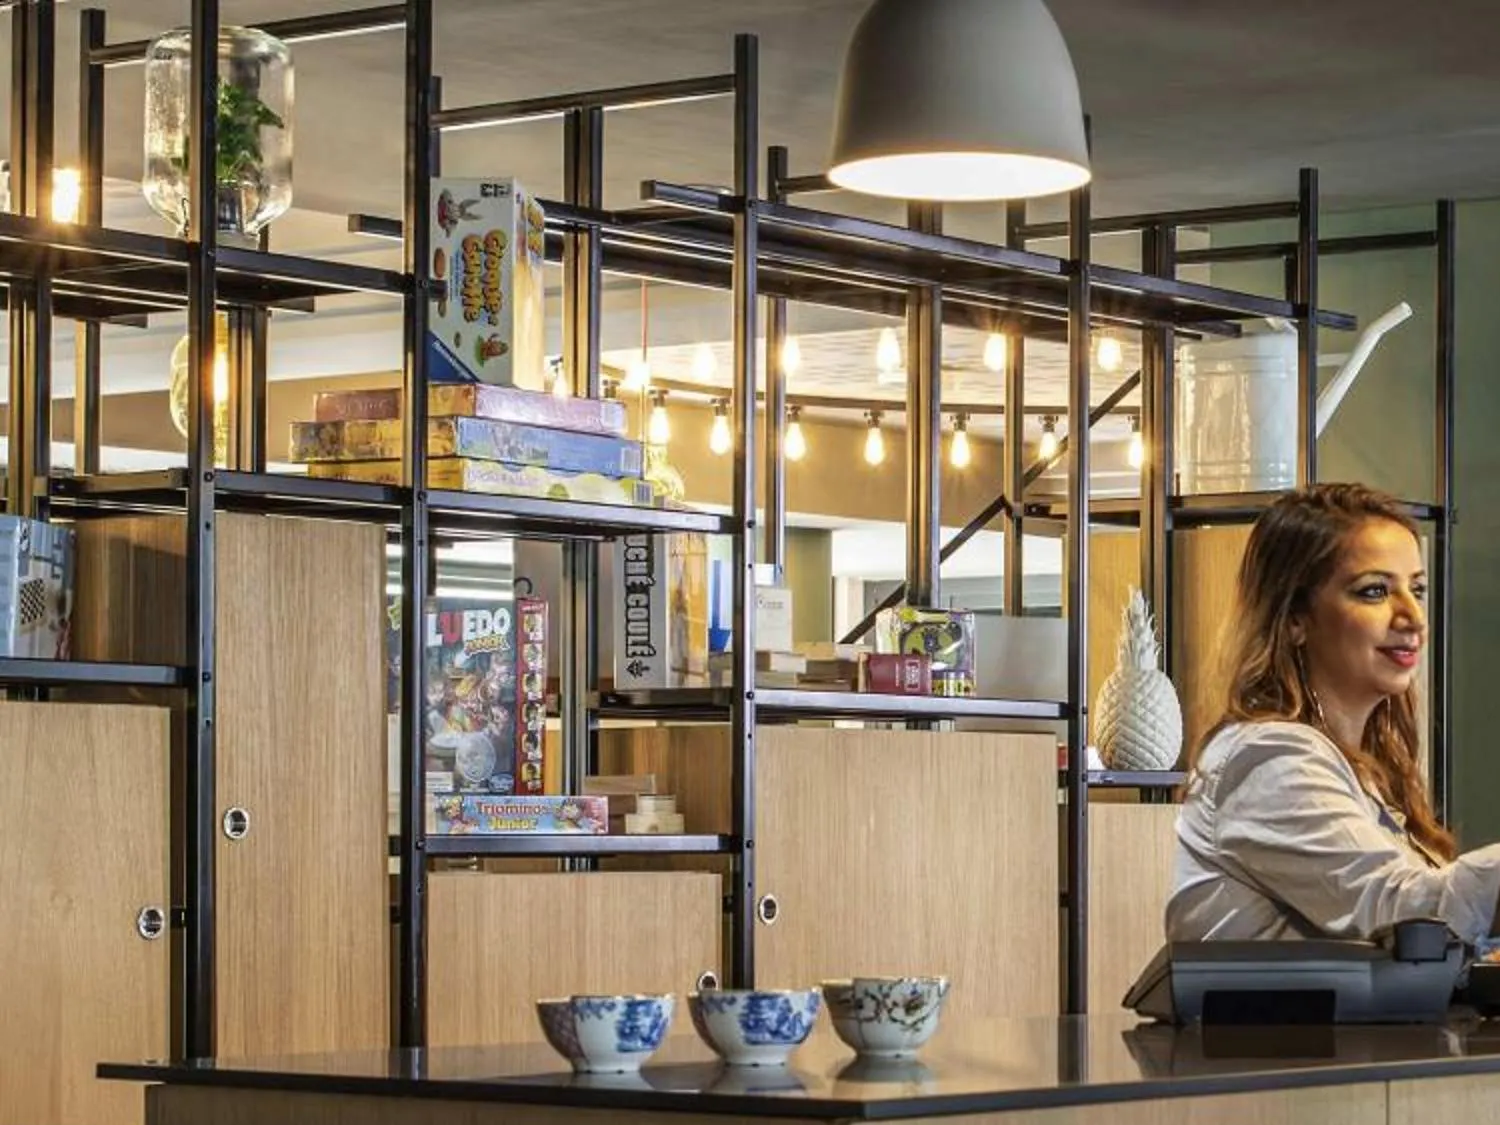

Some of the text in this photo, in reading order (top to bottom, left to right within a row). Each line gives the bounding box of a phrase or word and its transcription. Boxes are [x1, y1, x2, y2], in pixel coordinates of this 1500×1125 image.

[425, 607, 511, 647] LUEDO
[623, 534, 656, 658] UCHÉ COULÉ
